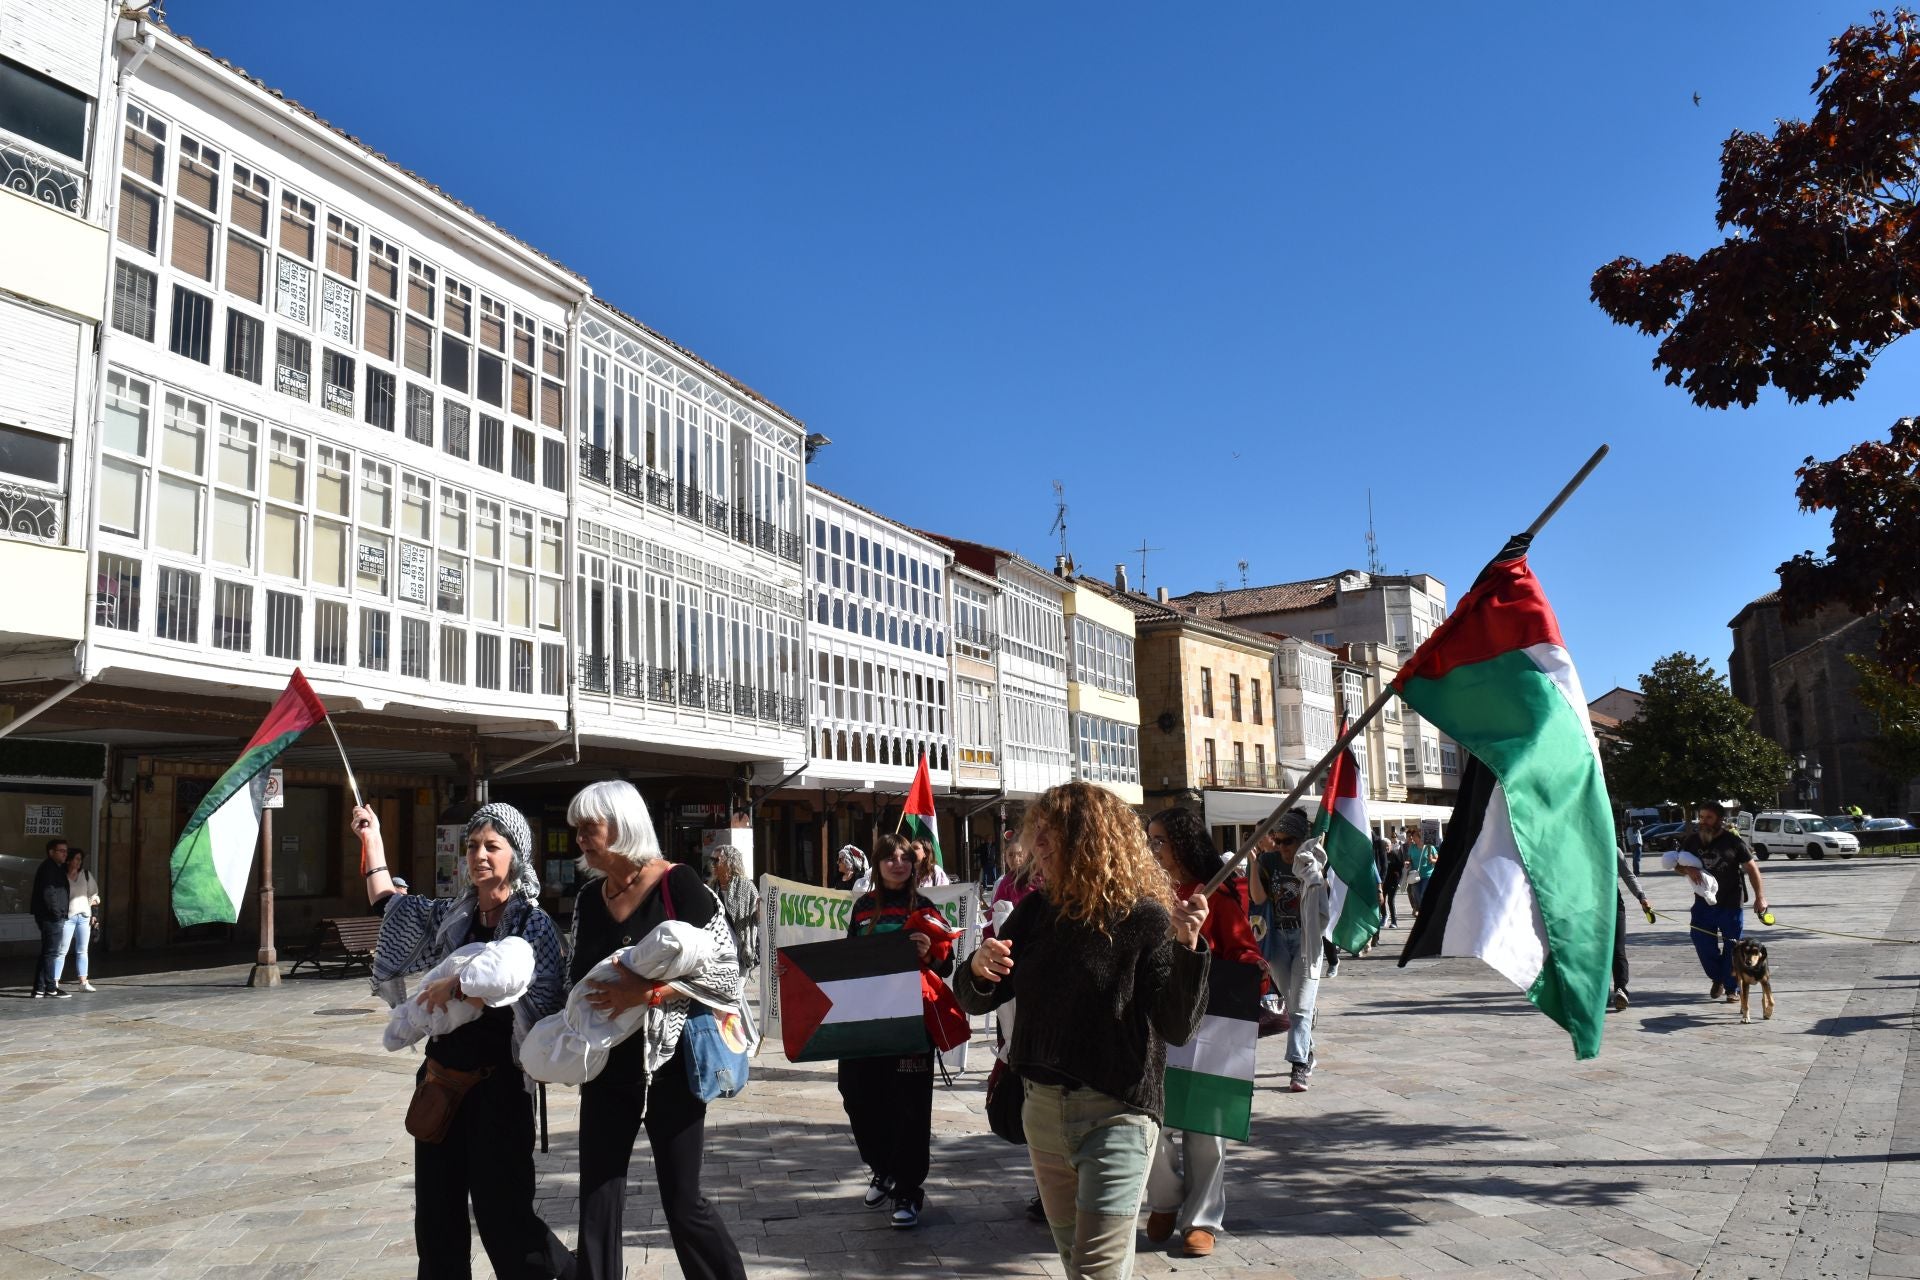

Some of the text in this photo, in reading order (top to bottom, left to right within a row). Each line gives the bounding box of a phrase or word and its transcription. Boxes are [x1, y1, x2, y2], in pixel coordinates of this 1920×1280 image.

[280, 368, 290, 377] SE
[279, 375, 307, 390] VENDE
[328, 386, 338, 394] SE
[327, 393, 352, 408] VENDE
[360, 546, 369, 554] SE
[360, 553, 384, 564] VENDE
[440, 574, 461, 584] VENDE
[780, 893, 853, 930] NUESTR
